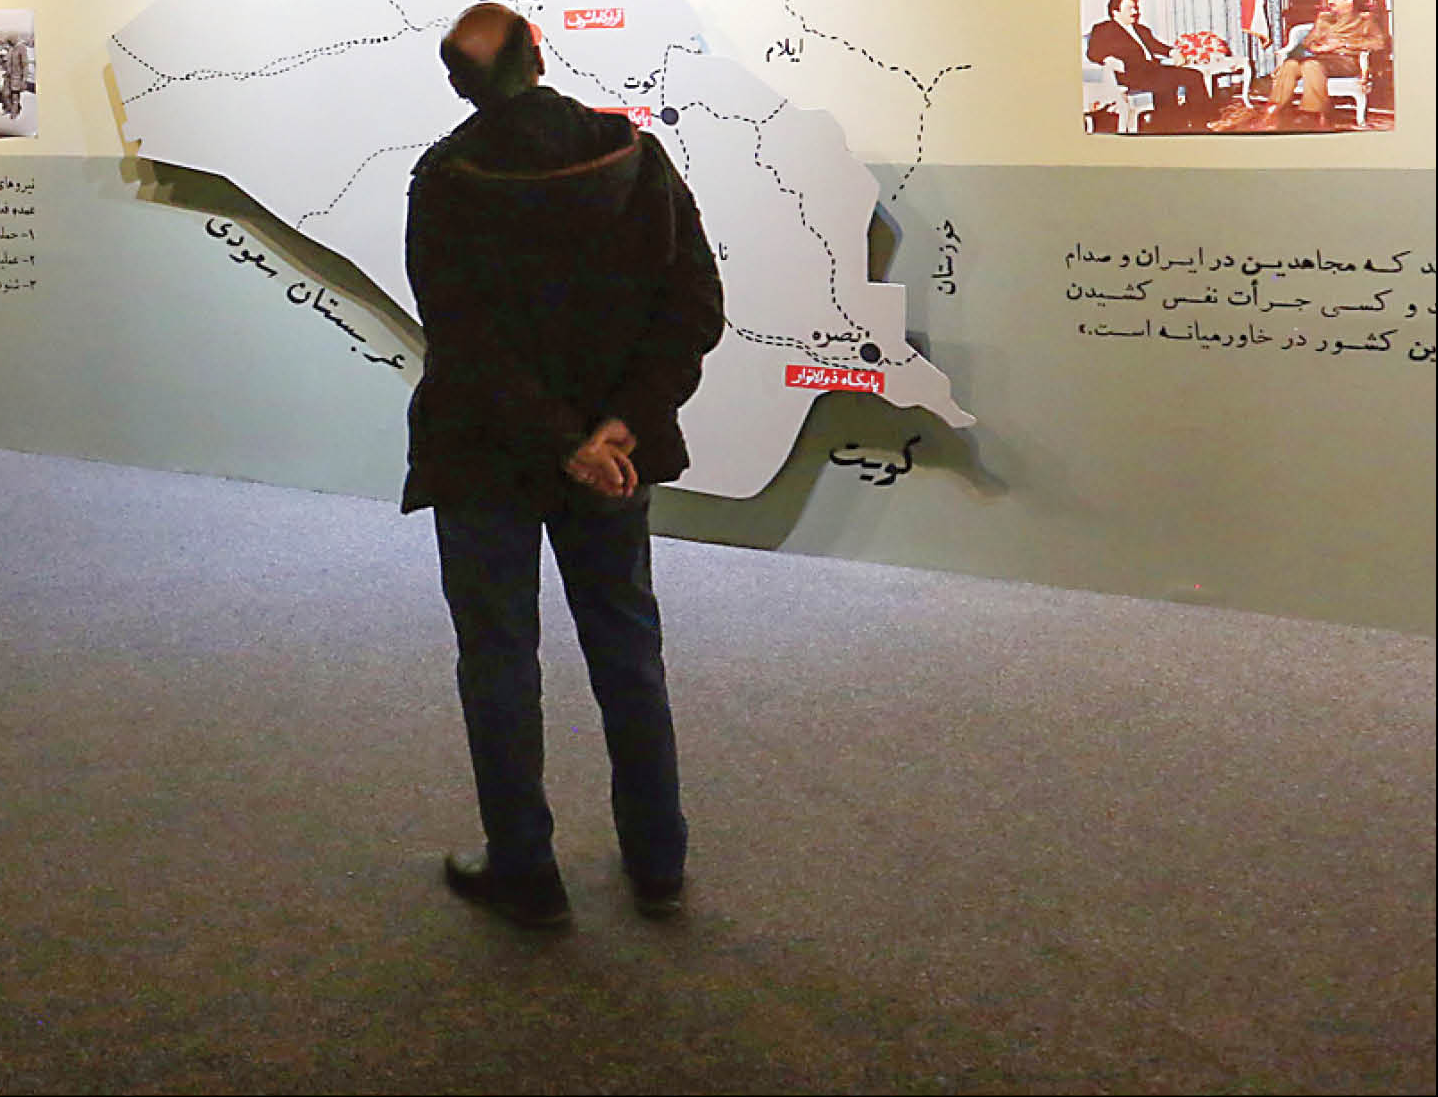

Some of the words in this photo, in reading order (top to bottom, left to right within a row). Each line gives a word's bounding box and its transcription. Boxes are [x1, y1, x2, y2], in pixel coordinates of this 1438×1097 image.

[765, 38, 804, 62] ایلام
[623, 68, 661, 94] کوت
[204, 216, 279, 278] سعودی
[1064, 242, 1112, 269] صدام
[1135, 245, 1204, 274] ایران
[1118, 254, 1131, 268] و
[1209, 255, 1235, 271] در
[1241, 249, 1357, 277] مجاهدین
[1363, 250, 1411, 274] که
[1066, 279, 1154, 307] کشیدن
[1162, 286, 1219, 310] نفس
[1227, 279, 1311, 312] جرأت
[1320, 288, 1394, 318] کسی
[1404, 303, 1418, 319] و
[287, 282, 406, 370] عربستان
[1159, 319, 1274, 350] خاورمیانه
[812, 330, 862, 352] بصره
[1281, 335, 1307, 350] در
[1315, 329, 1399, 355] کشور
[1408, 341, 1436, 362] ین
[842, 371, 880, 393] پایگاه
[829, 434, 922, 486] کویت
